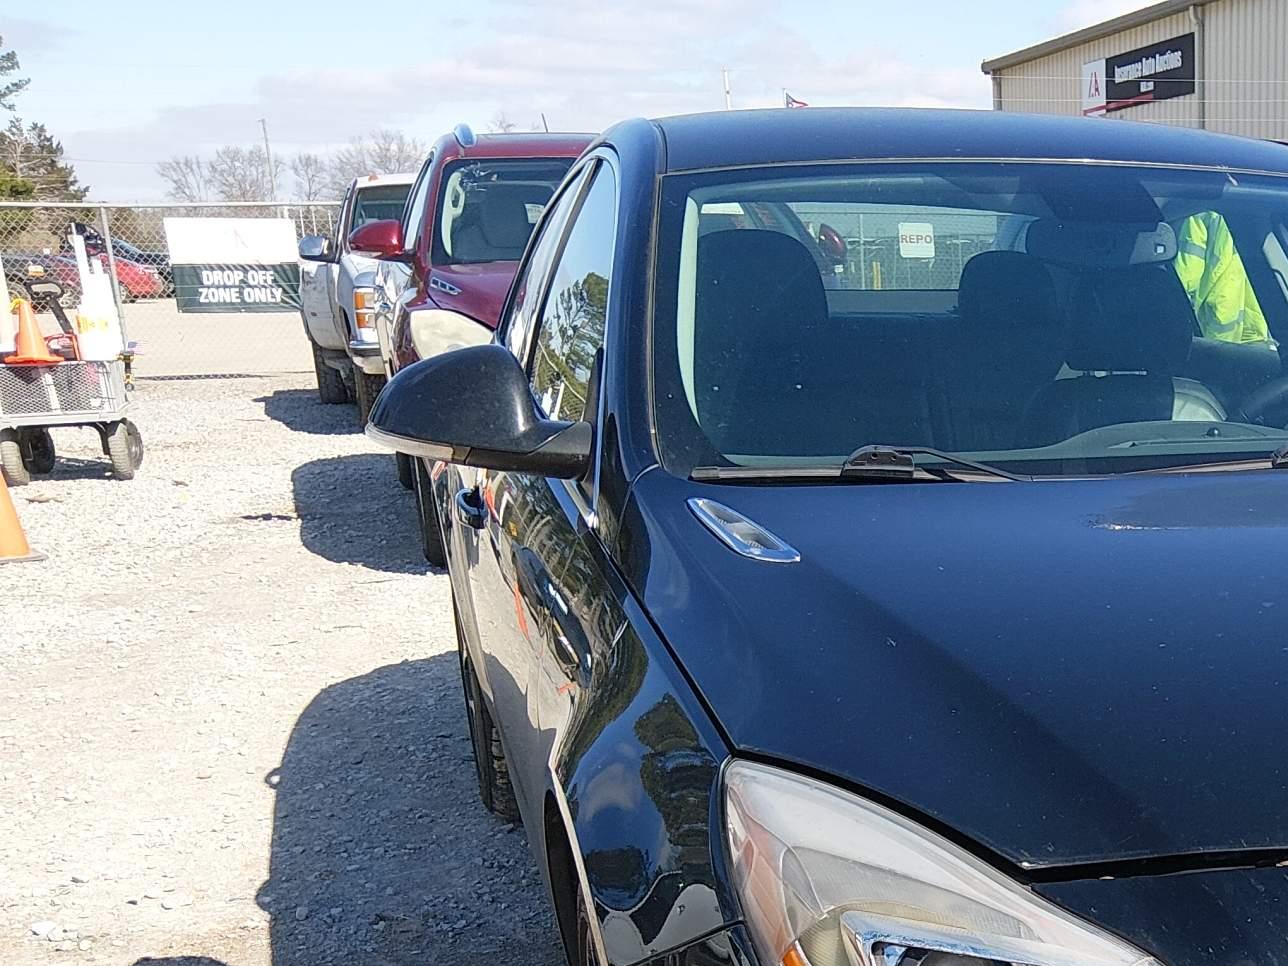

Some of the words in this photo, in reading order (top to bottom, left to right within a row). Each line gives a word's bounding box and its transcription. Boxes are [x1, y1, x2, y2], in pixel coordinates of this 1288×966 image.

[1156, 50, 1182, 73] Auctions
[901, 234, 933, 244] REPO
[202, 270, 244, 286] DROP
[247, 270, 275, 286] OFF
[198, 287, 241, 303] ZONE
[243, 287, 282, 303] ONLY
